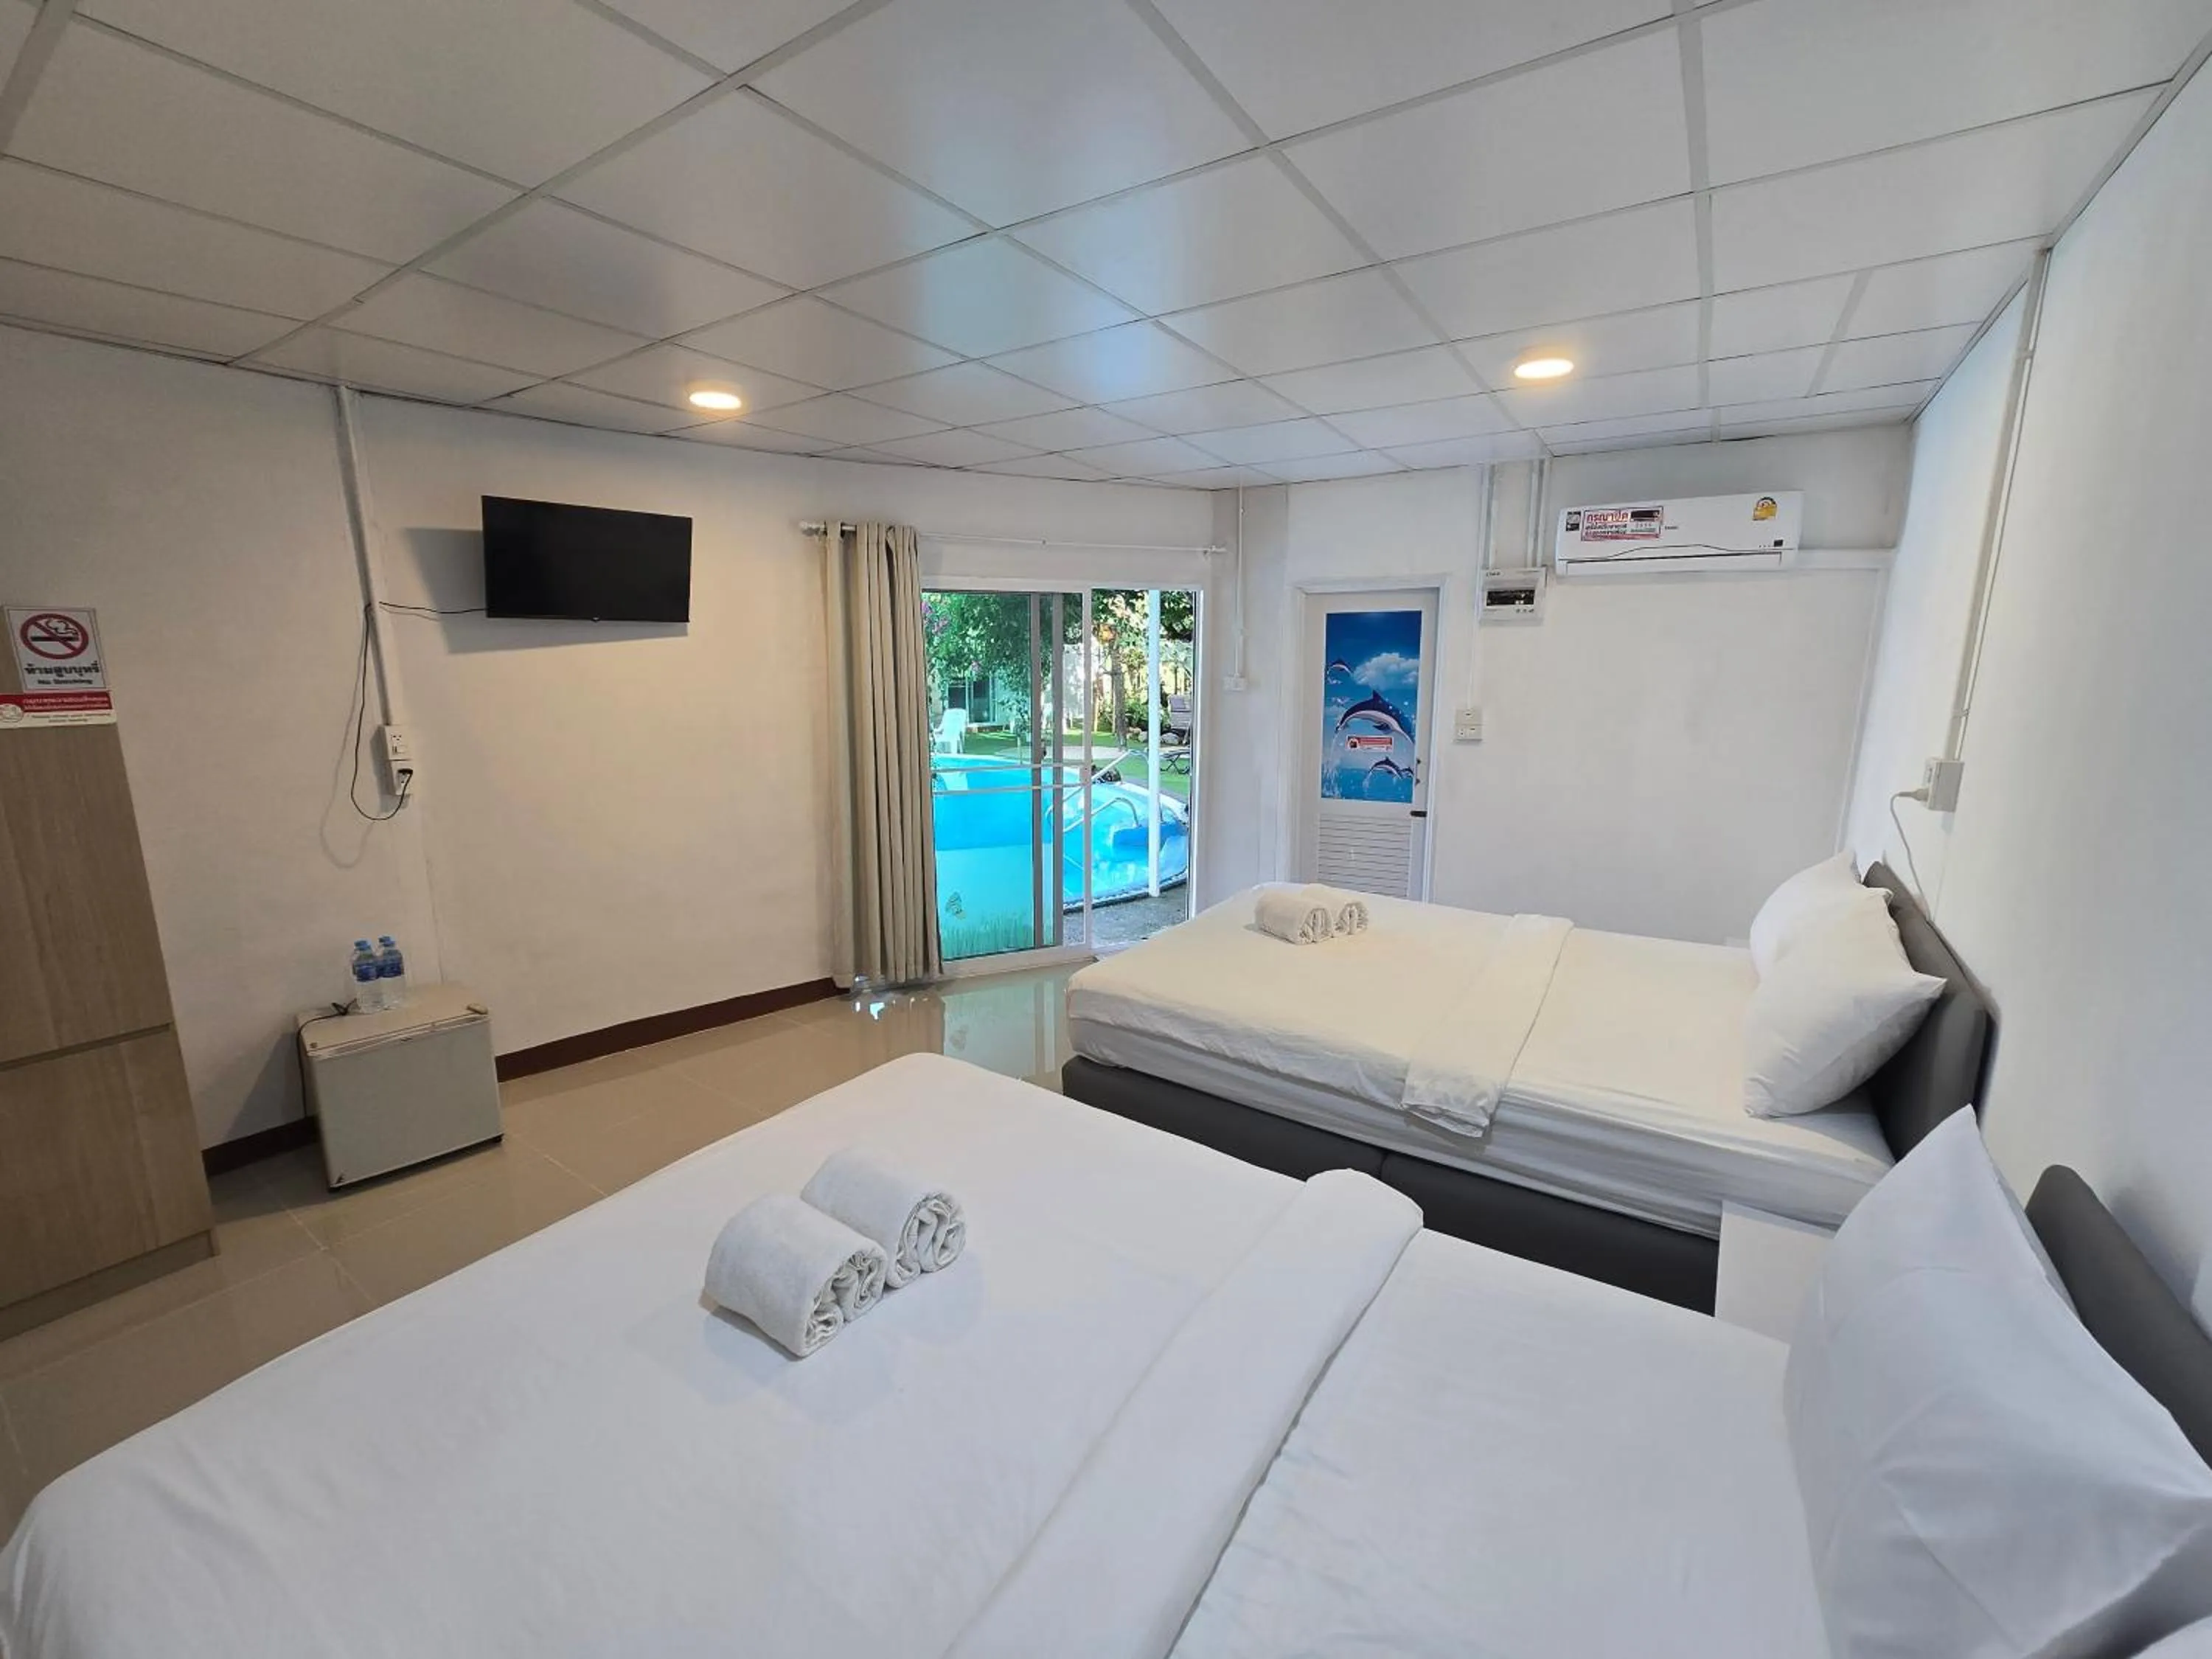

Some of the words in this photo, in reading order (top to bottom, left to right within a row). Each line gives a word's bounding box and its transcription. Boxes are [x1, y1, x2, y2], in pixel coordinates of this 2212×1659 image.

[24, 660, 100, 678] ห้ามสูบบุหรี่
